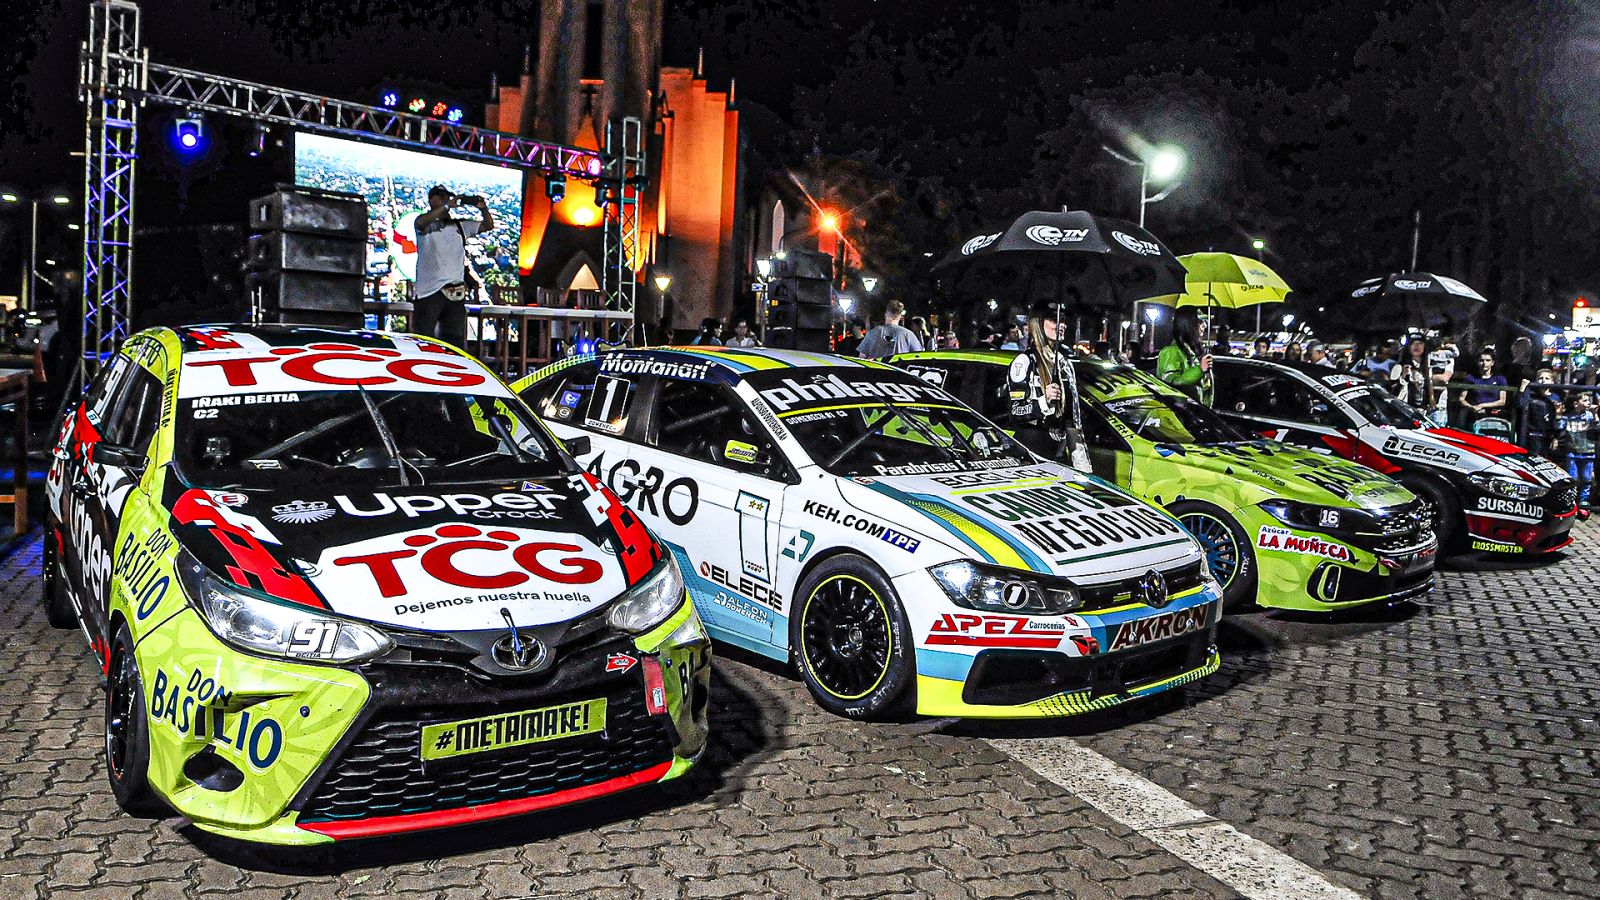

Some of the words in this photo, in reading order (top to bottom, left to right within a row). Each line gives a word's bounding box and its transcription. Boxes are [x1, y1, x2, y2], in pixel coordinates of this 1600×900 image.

[185, 353, 485, 387] TCG
[600, 353, 709, 379] Montanari
[192, 395, 241, 409] IÑAKI
[245, 393, 299, 405] BEITIA
[599, 379, 618, 422] 1
[759, 374, 952, 410] philagro
[194, 409, 218, 420] C2
[786, 412, 826, 425] DOMENECH
[1400, 442, 1461, 462] LECAR
[872, 460, 956, 477] Parabrisas
[586, 450, 699, 526] AGRO
[962, 481, 1100, 521] CAMPO
[335, 491, 568, 518] Upper
[803, 499, 884, 539] KEH.COM
[1322, 510, 1338, 524] 16
[1478, 497, 1543, 518] SURSALUD
[146, 527, 172, 561] DON
[734, 489, 771, 585] 1
[885, 529, 920, 553] YPF
[1012, 507, 1180, 555] NEGOCIOS
[1259, 534, 1280, 549] LA
[1284, 536, 1348, 560] MUÑECA
[1472, 541, 1524, 553] CROSSMASTER
[114, 532, 170, 621] BASILIO
[333, 540, 604, 597] TCG
[711, 564, 783, 611] ELECE
[1008, 585, 1023, 603] 1
[394, 594, 474, 615] Dejemos
[478, 591, 540, 603] nuestra
[542, 590, 591, 603] huella
[725, 603, 767, 624] DOMENECH
[728, 596, 768, 618] ALFON
[289, 622, 339, 653] 91
[930, 614, 1029, 635] APEZ
[1109, 604, 1208, 653] AKRON
[187, 668, 232, 707] DON
[152, 669, 285, 770] BASILIO
[434, 704, 591, 752] #METAMATE!
